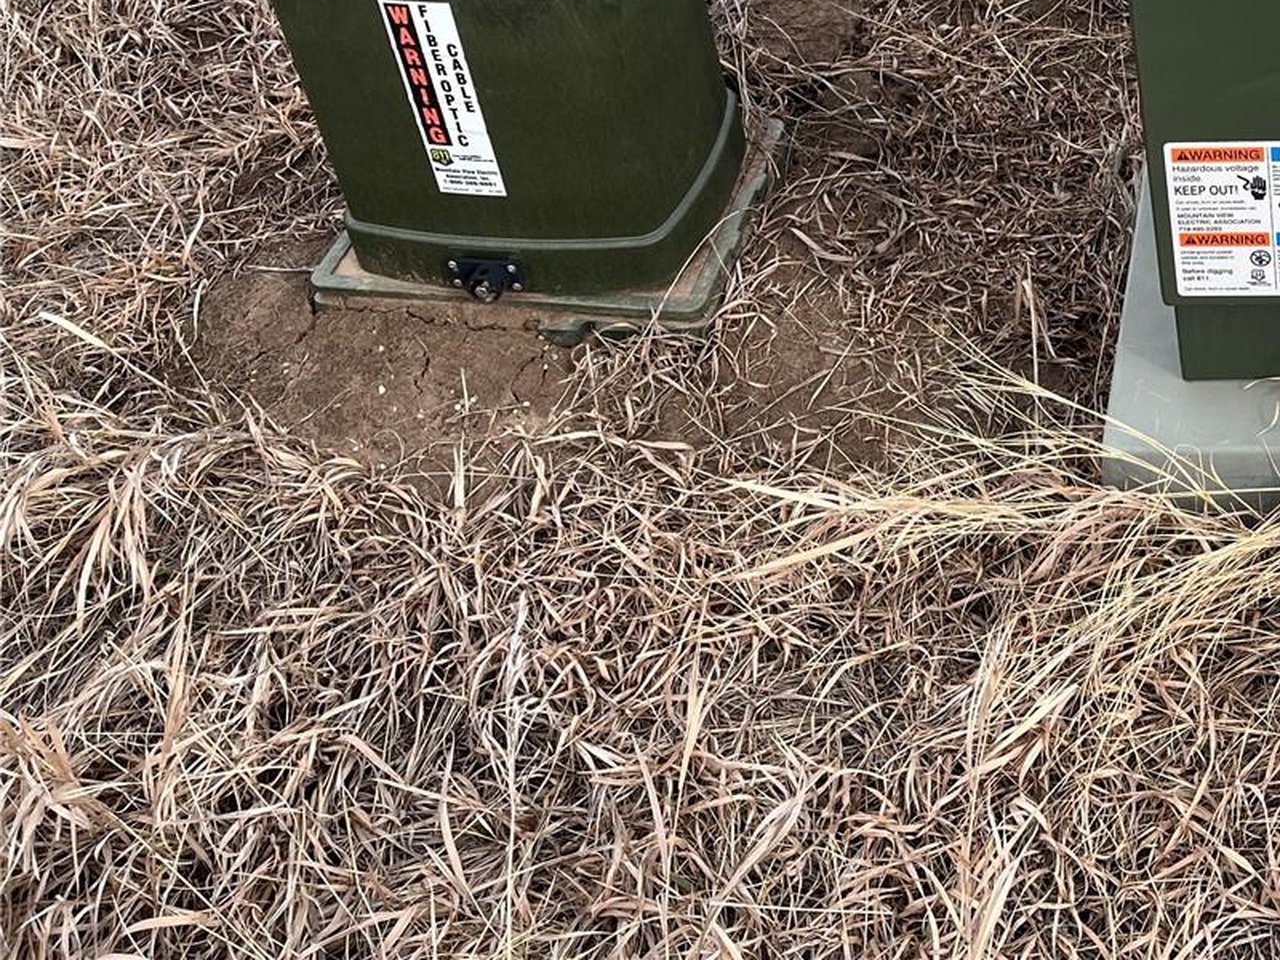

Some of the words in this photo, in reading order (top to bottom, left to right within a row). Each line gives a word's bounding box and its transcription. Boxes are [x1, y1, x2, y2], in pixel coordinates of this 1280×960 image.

[387, 6, 448, 144] WARNING
[417, 5, 448, 76] FIBER
[440, 80, 469, 147] OPTIC
[446, 44, 476, 113] CABLE
[1188, 149, 1261, 160] WARNING
[1225, 165, 1259, 173] voltage
[1174, 185, 1206, 196] KEEP
[1209, 185, 1238, 195] OUT!
[1197, 235, 1266, 245] WARNING
